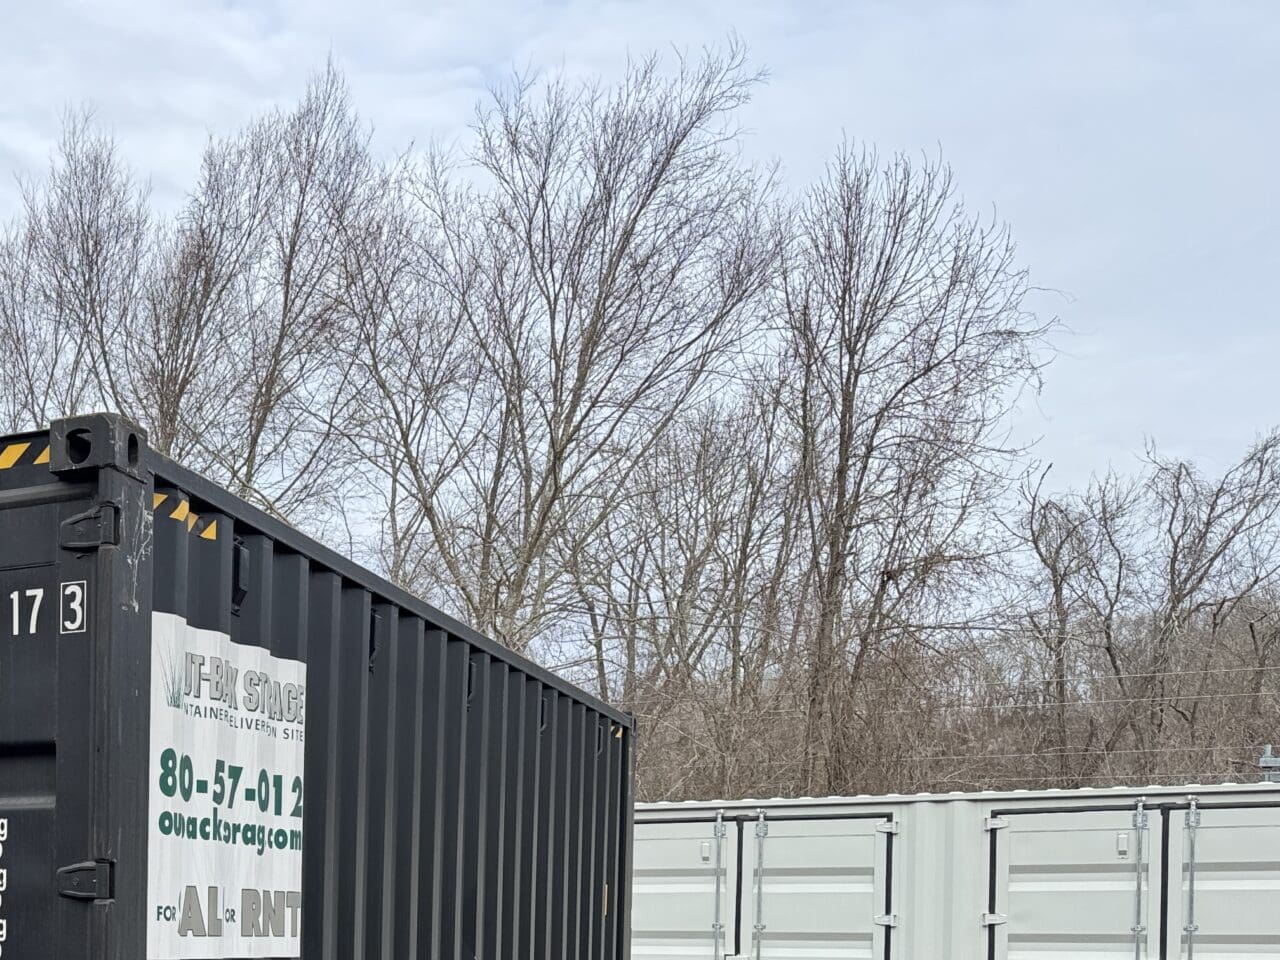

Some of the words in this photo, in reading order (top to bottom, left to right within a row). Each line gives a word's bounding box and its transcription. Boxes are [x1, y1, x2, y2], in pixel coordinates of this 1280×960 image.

[63, 584, 83, 630] 3
[282, 727, 304, 742] SITE
[156, 905, 177, 922] FOR
[225, 908, 236, 923] OR
